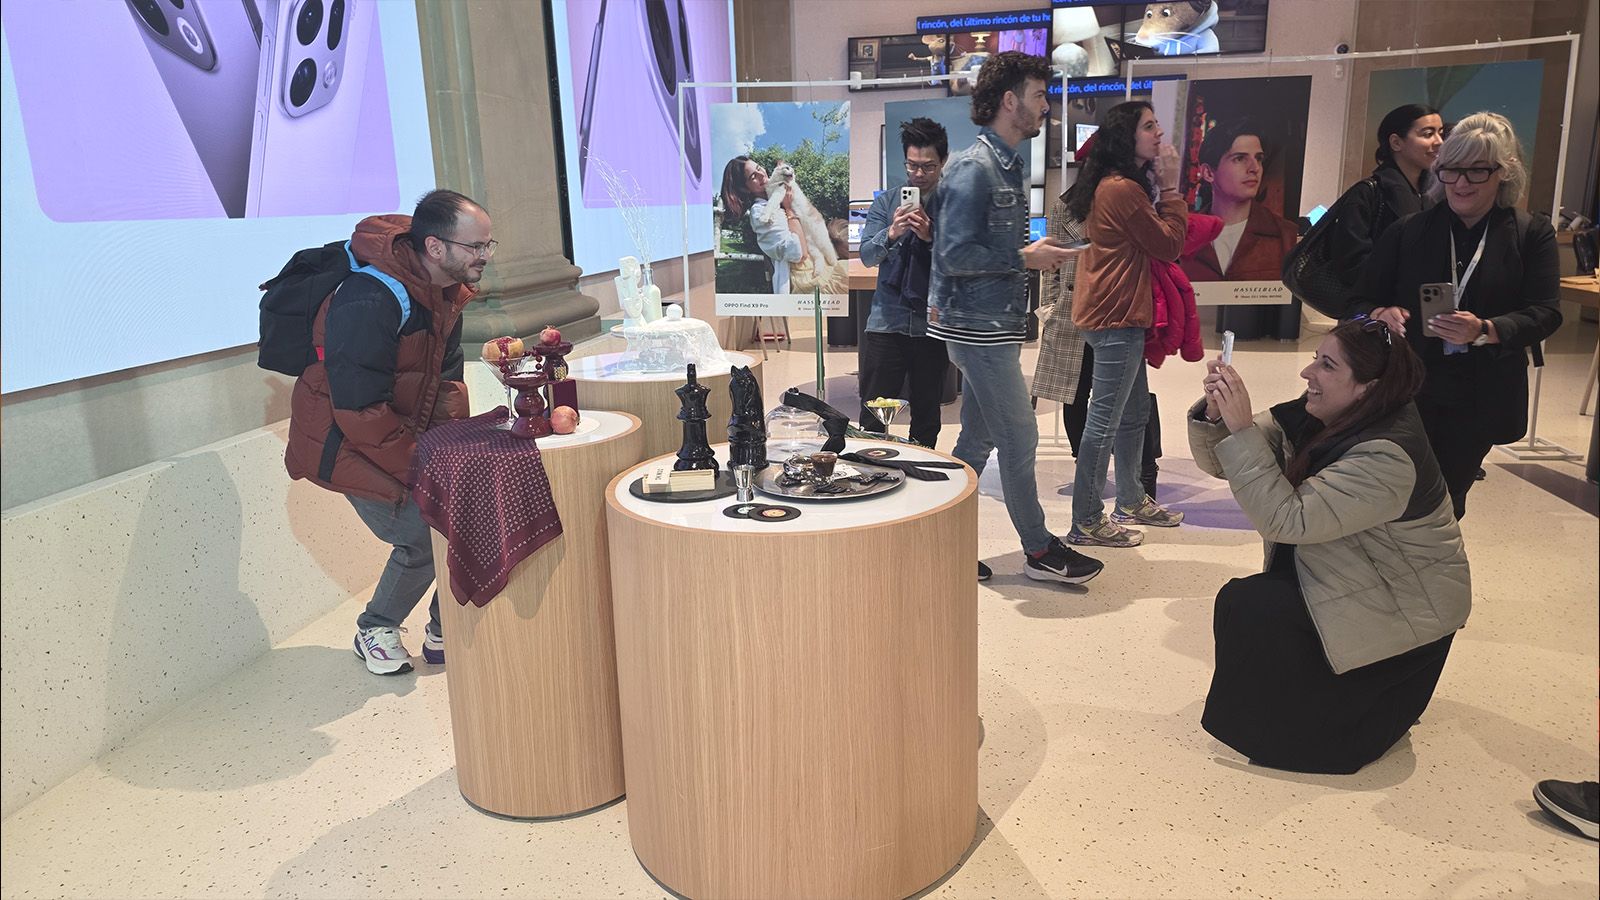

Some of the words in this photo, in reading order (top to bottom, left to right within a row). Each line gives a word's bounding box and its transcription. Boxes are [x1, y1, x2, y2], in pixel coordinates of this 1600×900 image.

[921, 19, 949, 28] rincón,
[949, 18, 963, 28] del
[964, 16, 992, 26] último
[992, 14, 1018, 25] rincón
[1019, 13, 1031, 23] de
[1032, 14, 1041, 22] tu
[1054, 84, 1082, 94] rinón,
[1083, 83, 1097, 92] del
